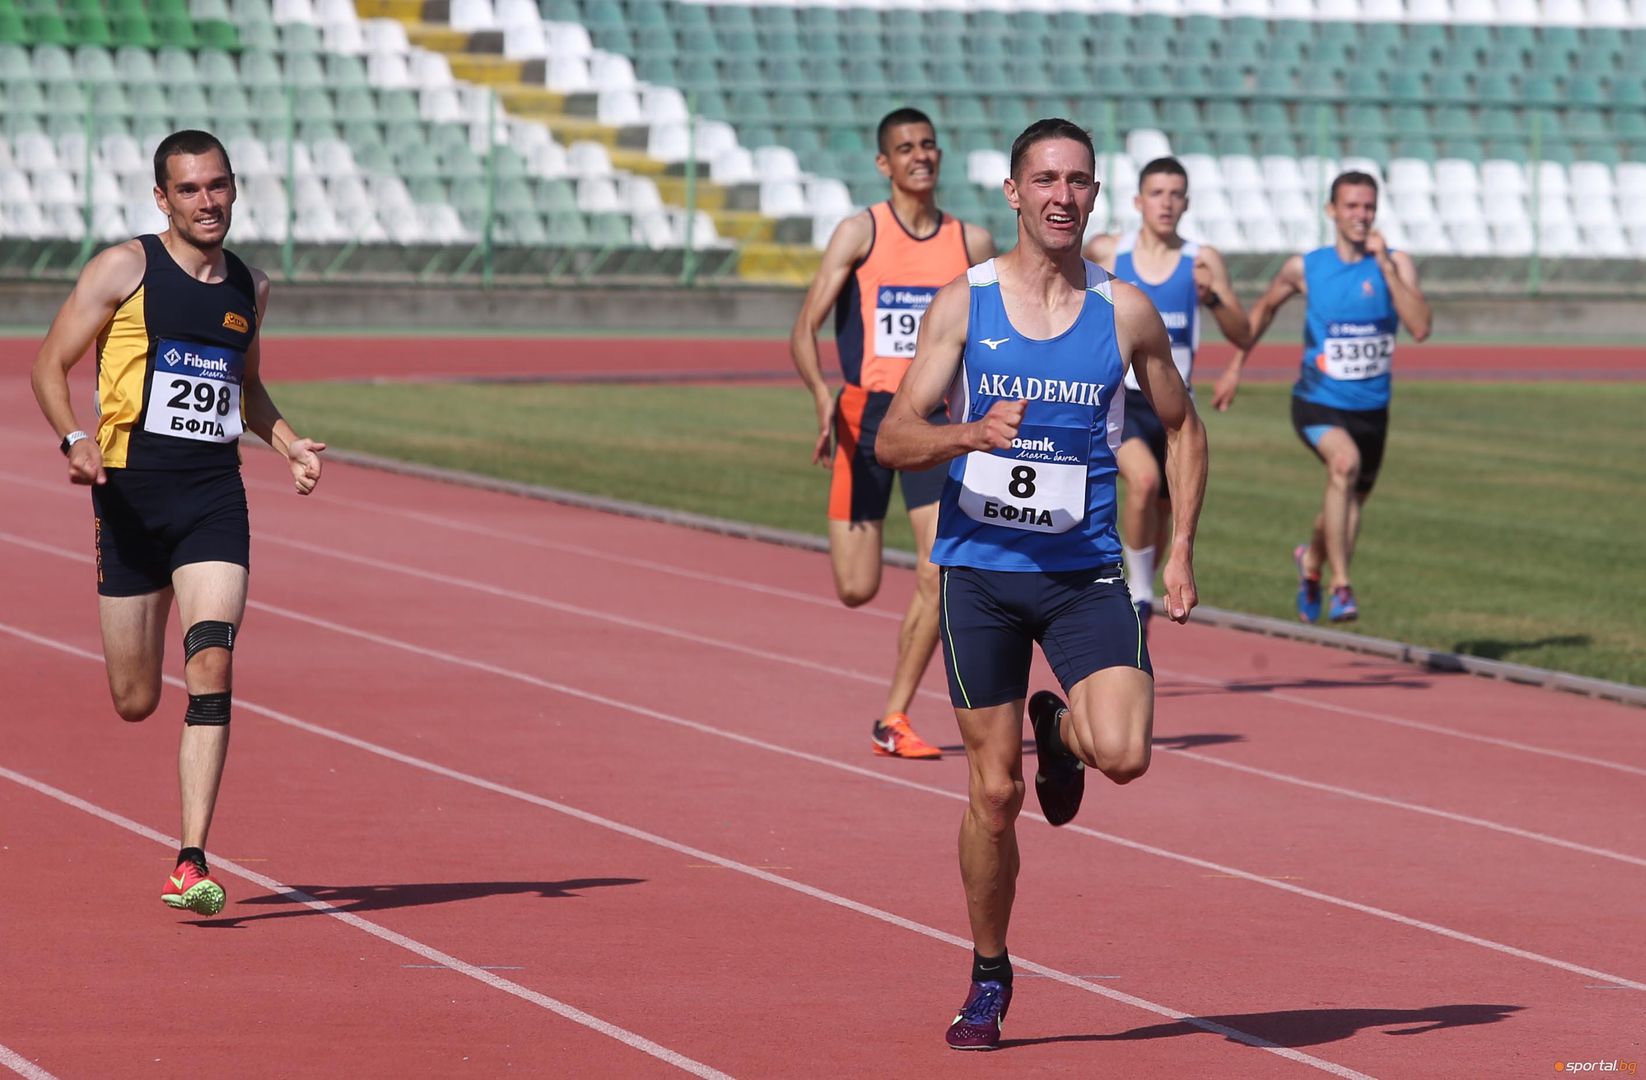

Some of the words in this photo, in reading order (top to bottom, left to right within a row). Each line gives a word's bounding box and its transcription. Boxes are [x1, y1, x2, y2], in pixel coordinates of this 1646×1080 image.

[880, 313, 920, 335] 19
[183, 352, 228, 372] Fibank
[166, 378, 231, 416] 298
[977, 373, 1105, 407] AKADEMIK
[170, 416, 225, 438] БФЛА
[1008, 465, 1037, 499] 8
[983, 501, 1054, 527] БФЛА
